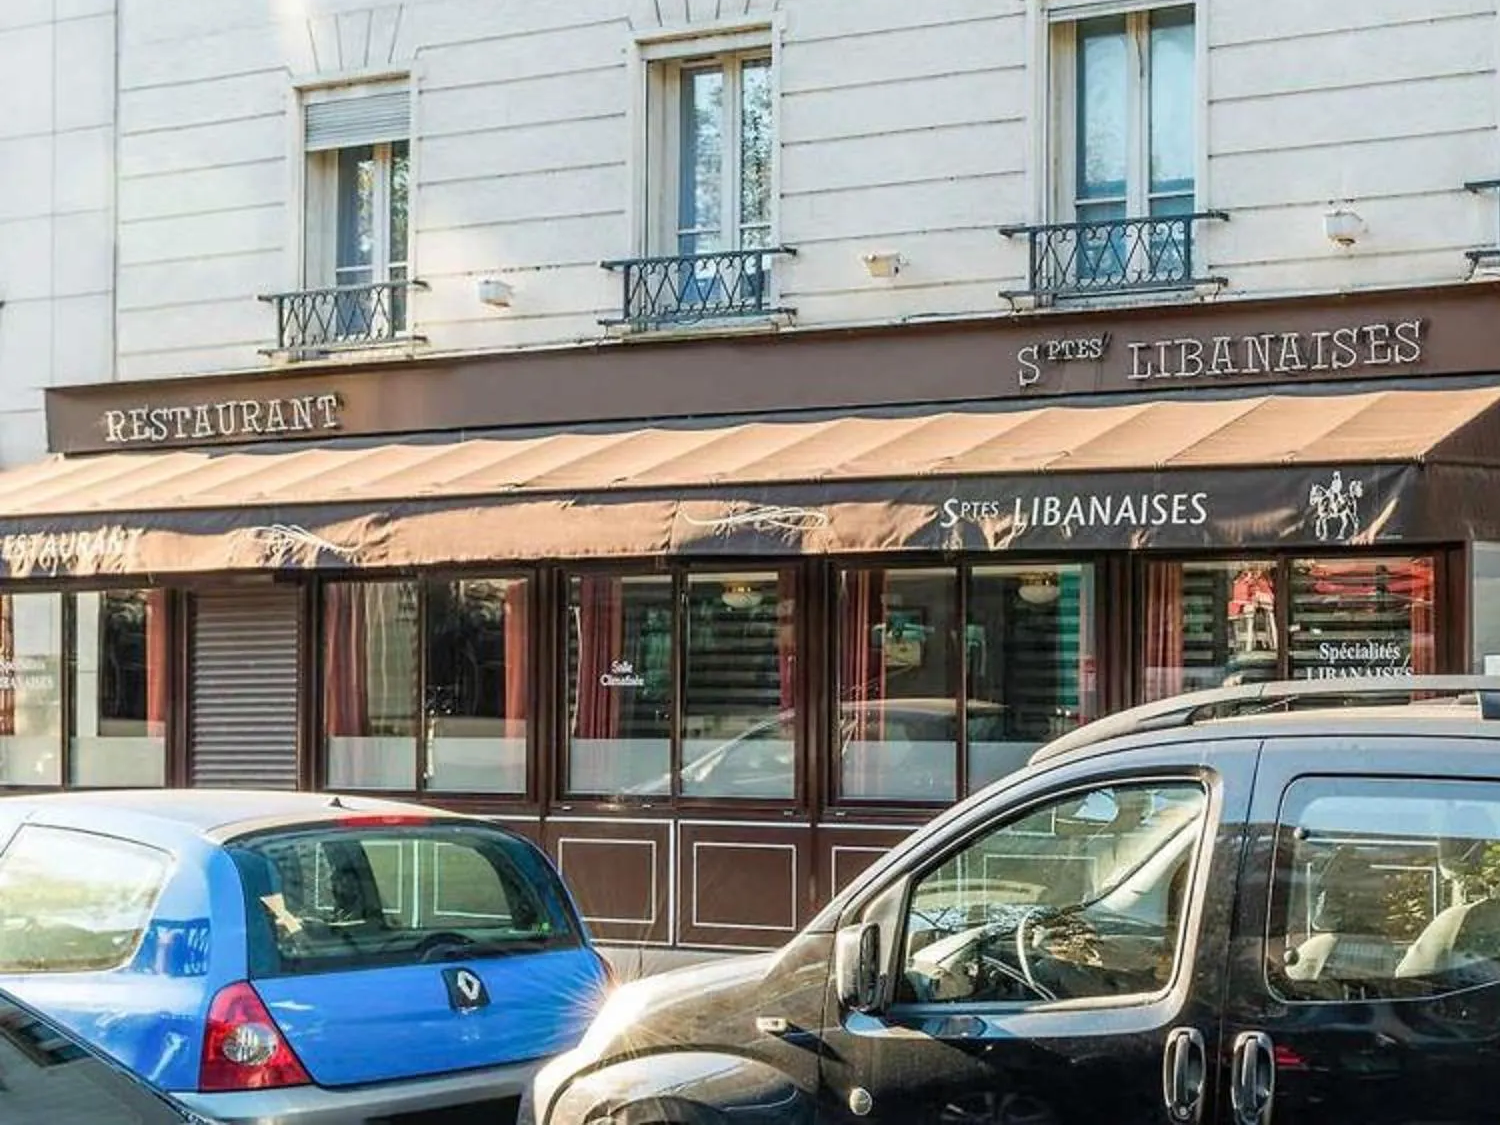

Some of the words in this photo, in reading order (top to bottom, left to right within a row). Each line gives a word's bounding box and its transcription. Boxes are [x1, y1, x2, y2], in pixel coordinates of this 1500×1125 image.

[1127, 321, 1422, 379] LIBANAISES
[104, 394, 338, 443] RESTAURANT
[1014, 492, 1208, 527] LIBANAISES
[0, 525, 144, 563] ESTAURANT
[1319, 639, 1401, 664] Spécialités
